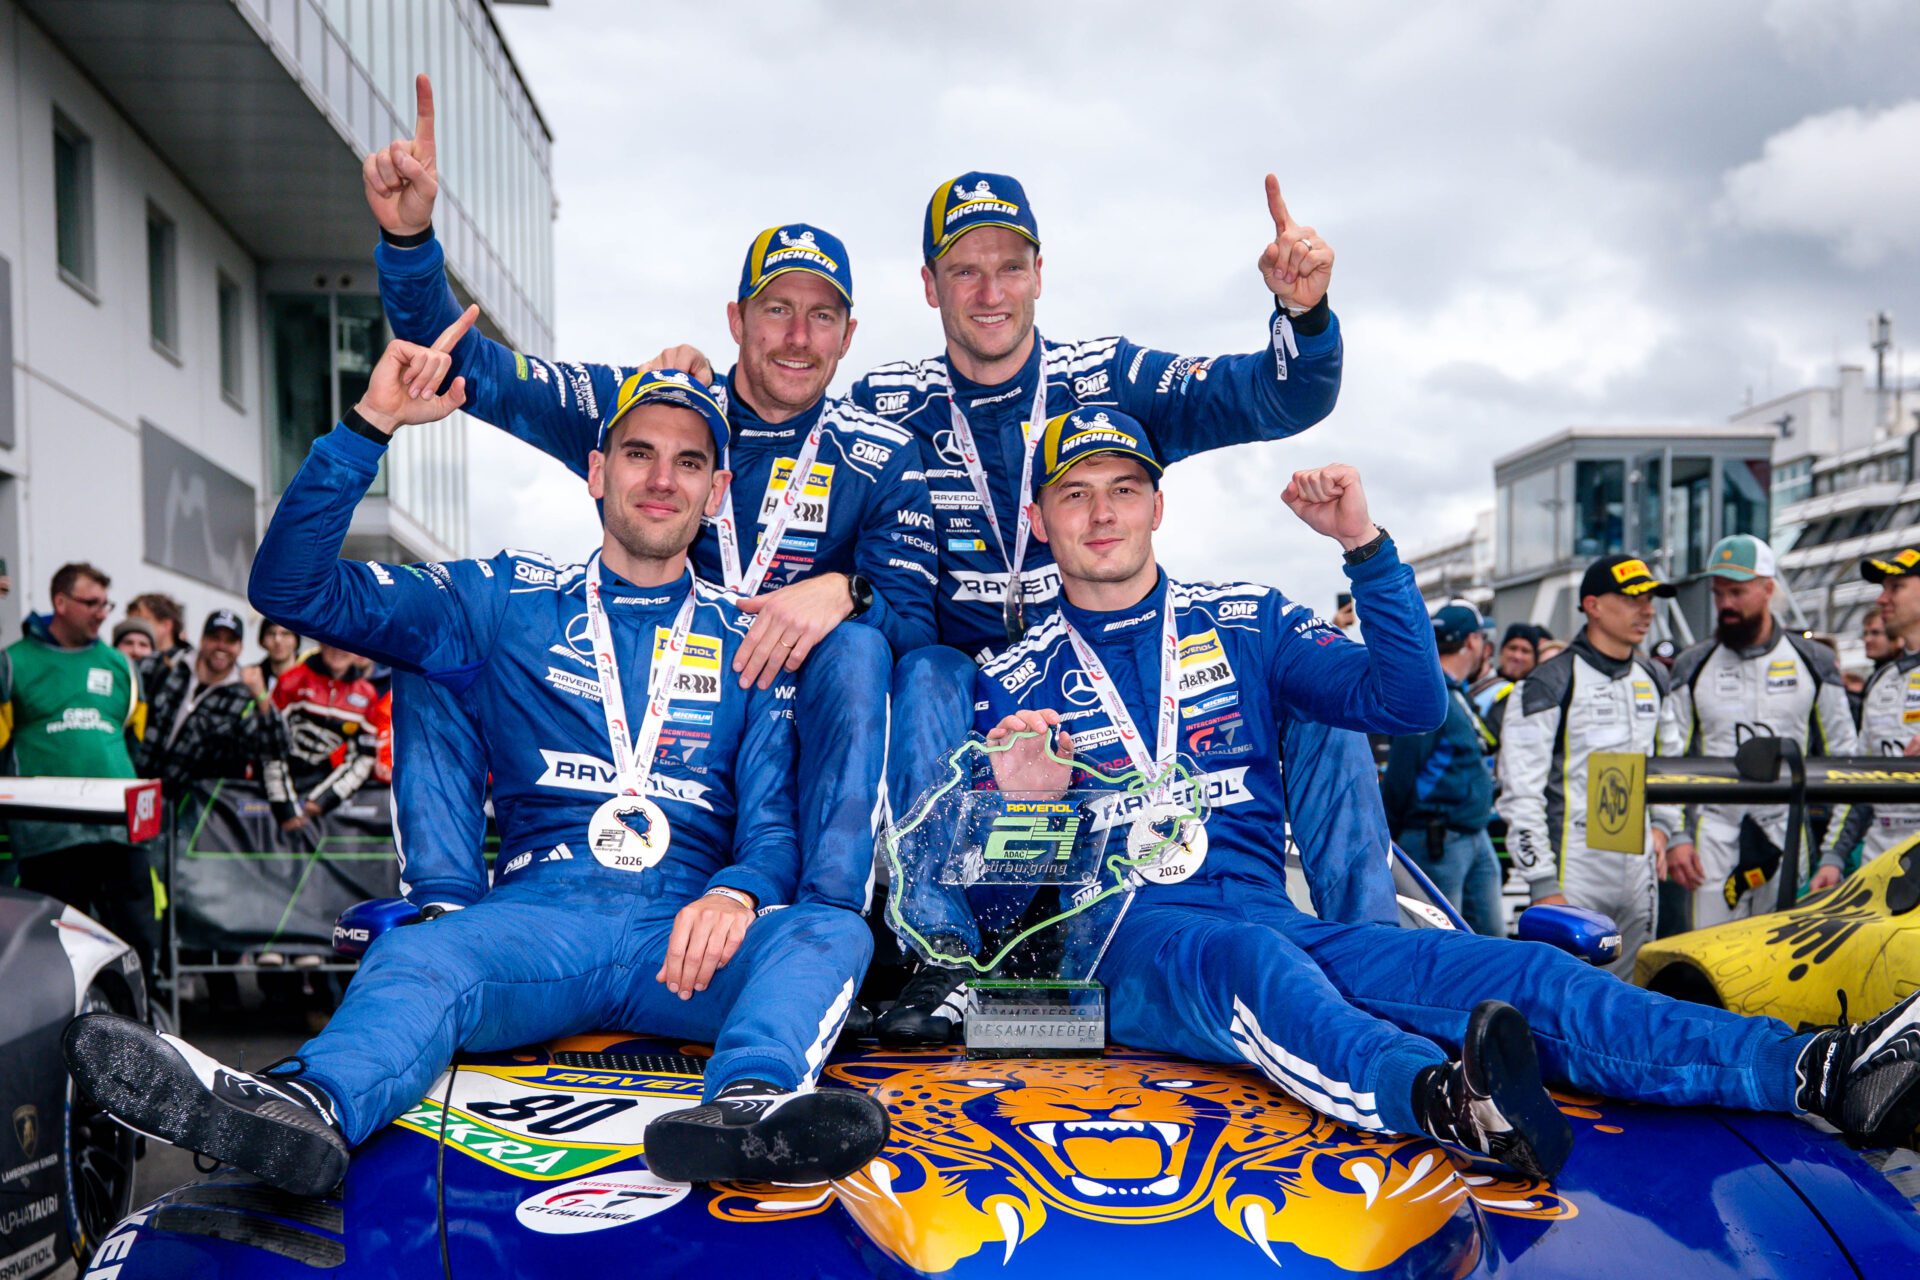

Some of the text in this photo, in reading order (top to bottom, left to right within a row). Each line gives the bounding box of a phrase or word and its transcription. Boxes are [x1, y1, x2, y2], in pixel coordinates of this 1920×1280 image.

[946, 202, 1019, 225] MICHELIN
[765, 251, 838, 274] MICHELIN
[1075, 374, 1109, 396] OMP
[875, 396, 909, 412] OMP
[1062, 434, 1138, 454] MICHELIN
[852, 444, 889, 464] OMP
[934, 493, 981, 502] RAVENOL
[950, 518, 972, 530] IWC
[902, 534, 938, 556] TECHEM
[774, 554, 816, 563] CONTINENTAL
[514, 564, 556, 583] OMP
[963, 573, 1062, 597] RAEN
[1219, 604, 1256, 622] OMP
[1003, 665, 1038, 691] OMP
[1179, 671, 1209, 690] H&R
[553, 684, 580, 697] RACING
[1202, 695, 1238, 711] MICHELIN
[672, 711, 712, 723] MICHELIN
[1185, 712, 1241, 731] INTERCONTINENTAL
[660, 730, 711, 740] ERCONTINENTAL
[1208, 743, 1253, 756] CHALLENGE
[1006, 804, 1074, 814] RAVENOL
[615, 856, 643, 867] 2026
[1004, 850, 1025, 859] ADAC
[1159, 865, 1187, 878] 2026
[333, 926, 369, 943] AMG
[974, 1024, 1107, 1038] GESAMTSIEGER
[466, 1094, 639, 1135] 80
[576, 1181, 682, 1194] INTERCONTINENTAL
[550, 1206, 637, 1222] CHALLENGE
